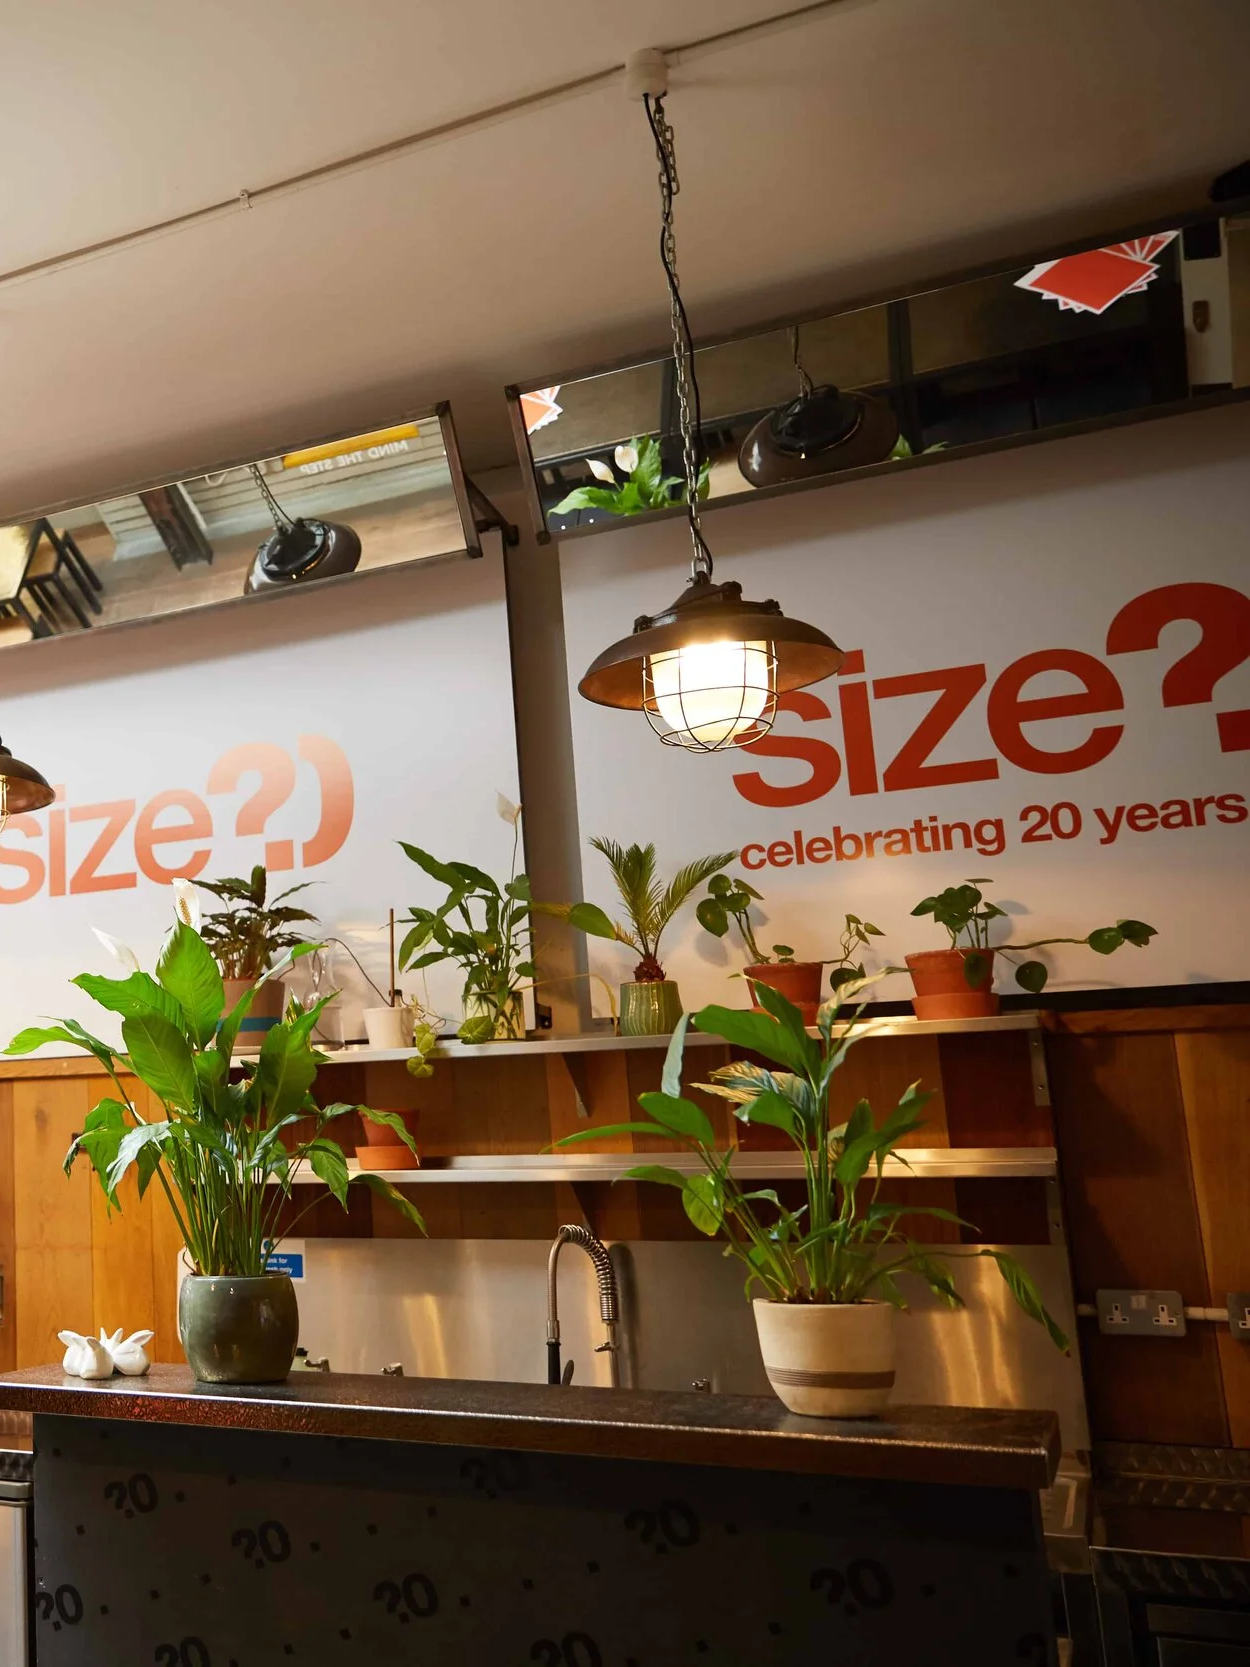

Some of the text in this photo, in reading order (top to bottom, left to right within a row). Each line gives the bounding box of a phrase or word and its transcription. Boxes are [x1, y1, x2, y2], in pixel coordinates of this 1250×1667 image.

[733, 582, 1250, 808] size?
[739, 792, 1249, 871] celebrating 20 years
